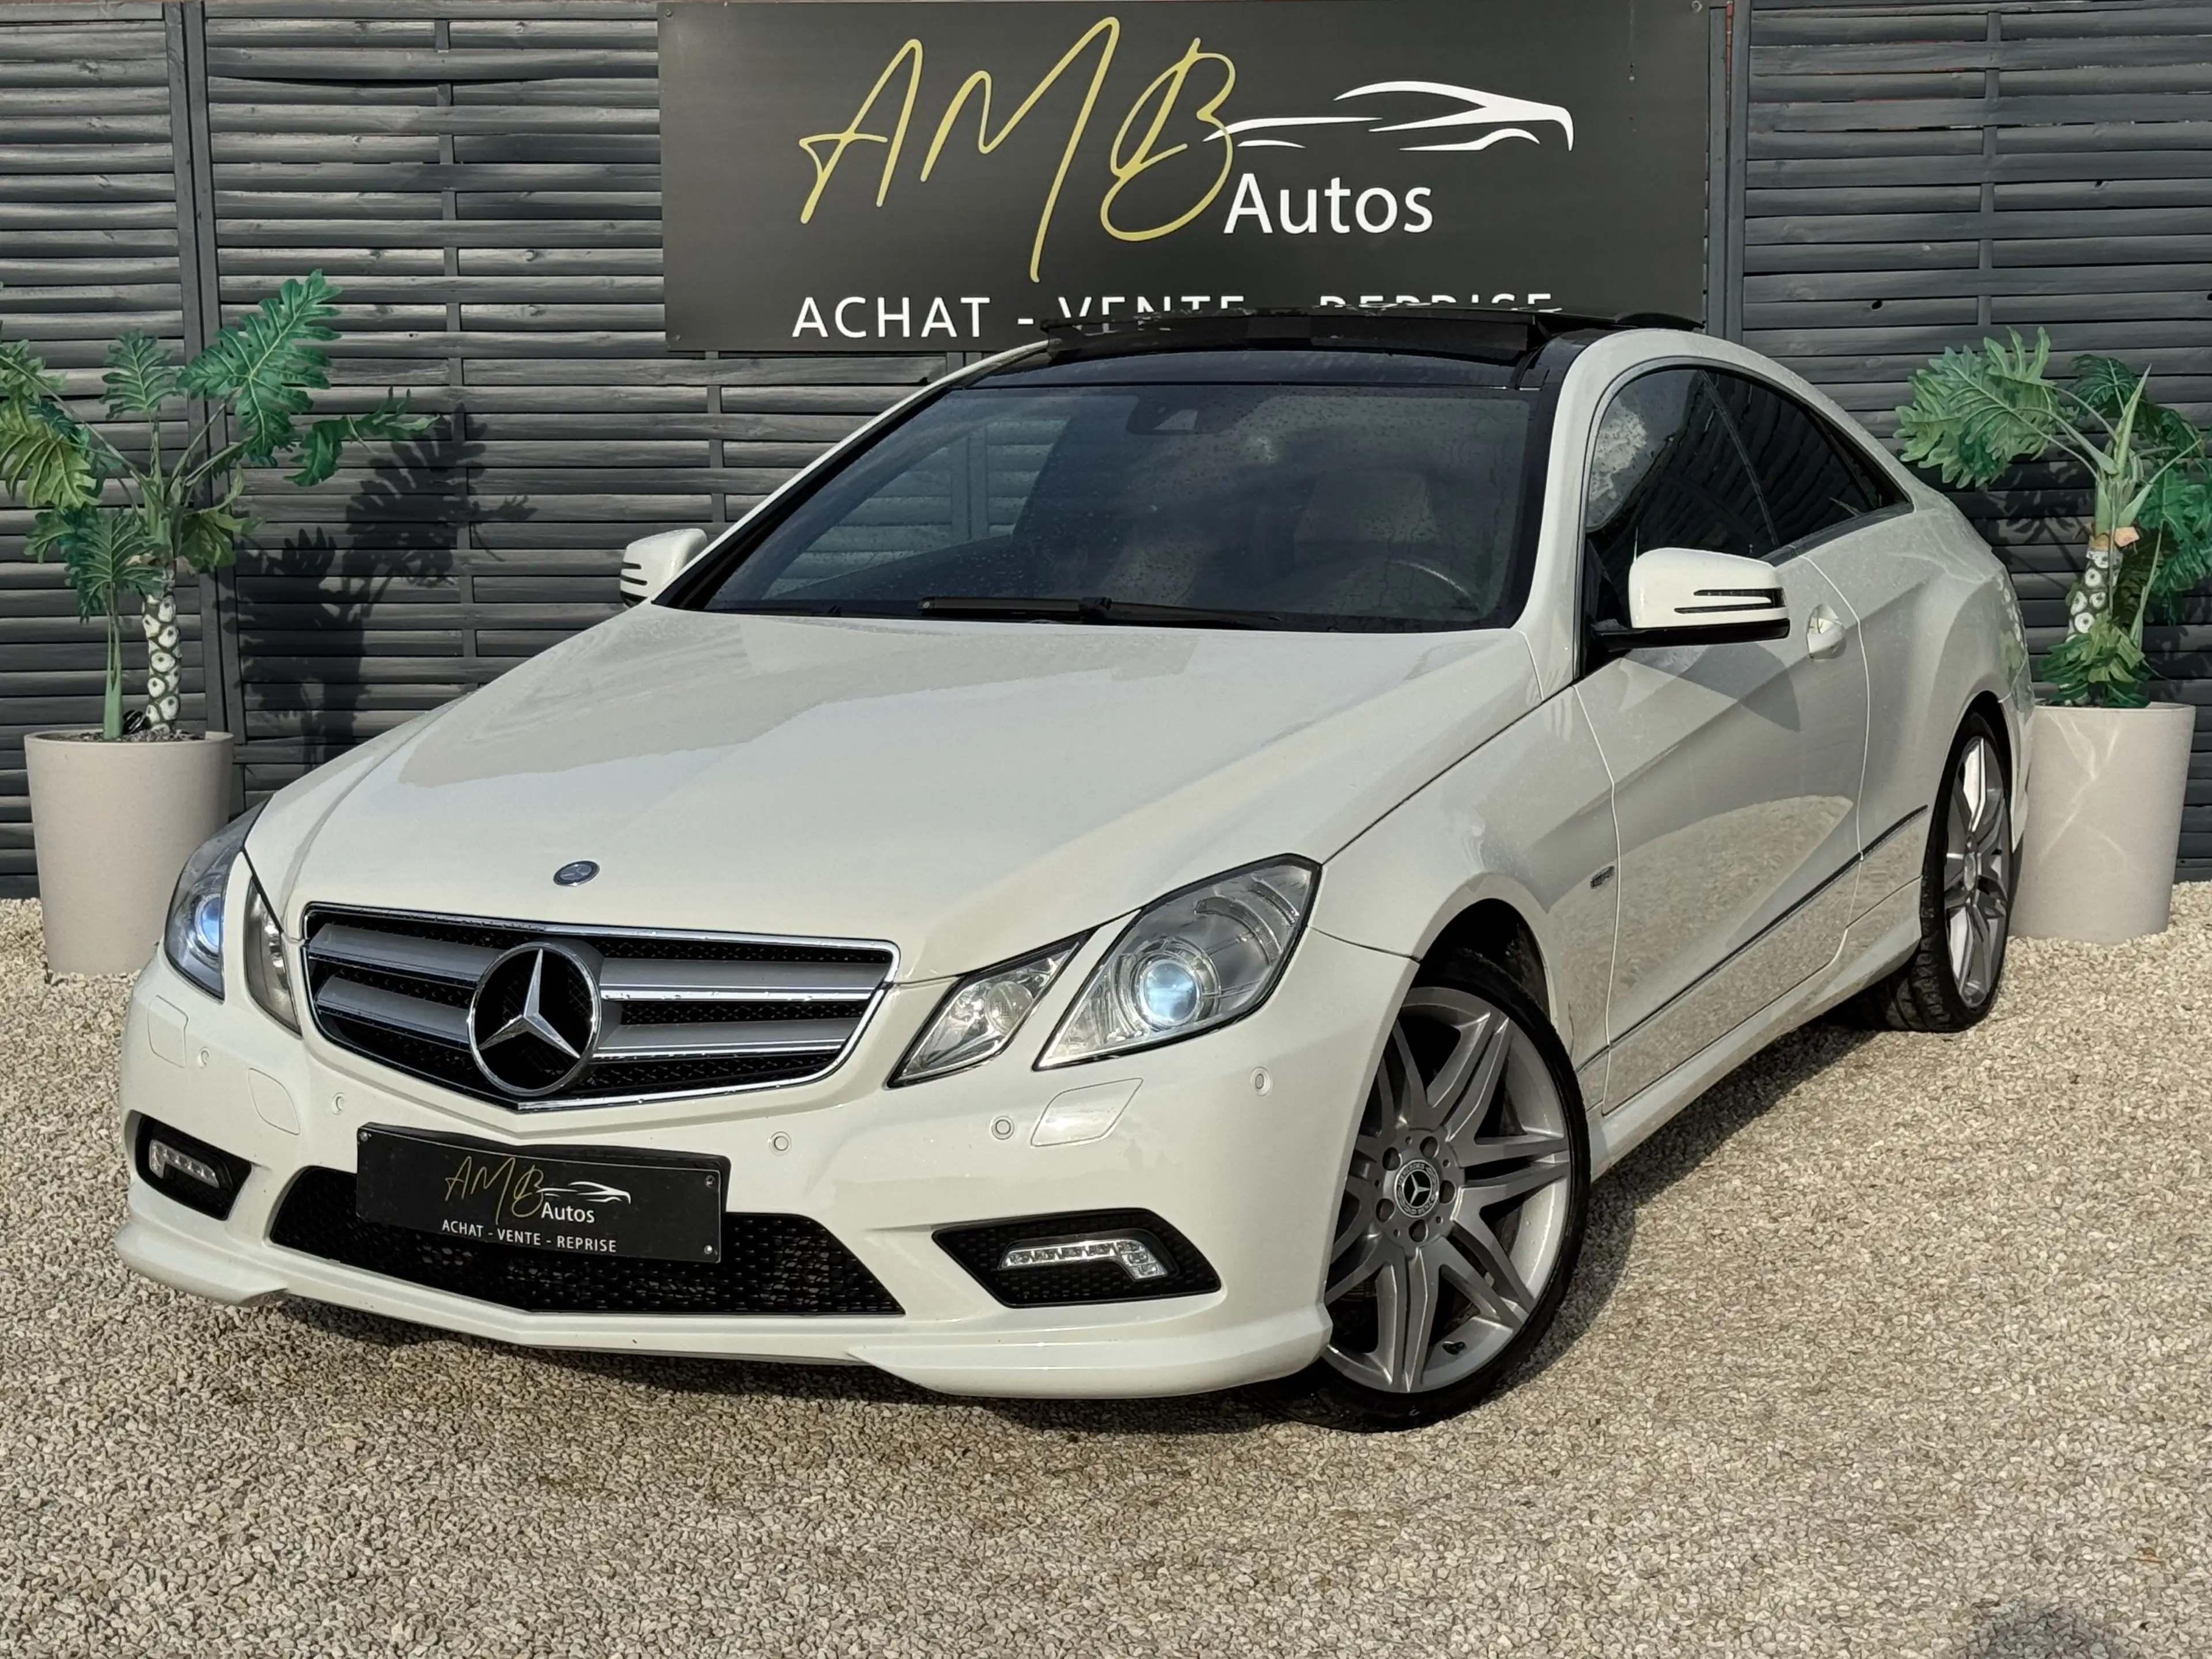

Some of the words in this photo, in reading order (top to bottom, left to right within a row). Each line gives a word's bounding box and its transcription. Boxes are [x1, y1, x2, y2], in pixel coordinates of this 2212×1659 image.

[799, 17, 1235, 282] AMB
[1224, 173, 1433, 234] Autos
[793, 297, 990, 338] ACHAT
[445, 1156, 544, 1225] AMB
[541, 1202, 595, 1224] Autos
[442, 1219, 484, 1237] ACHAT
[497, 1228, 541, 1246] VENTE
[557, 1235, 617, 1252] REPRISE
